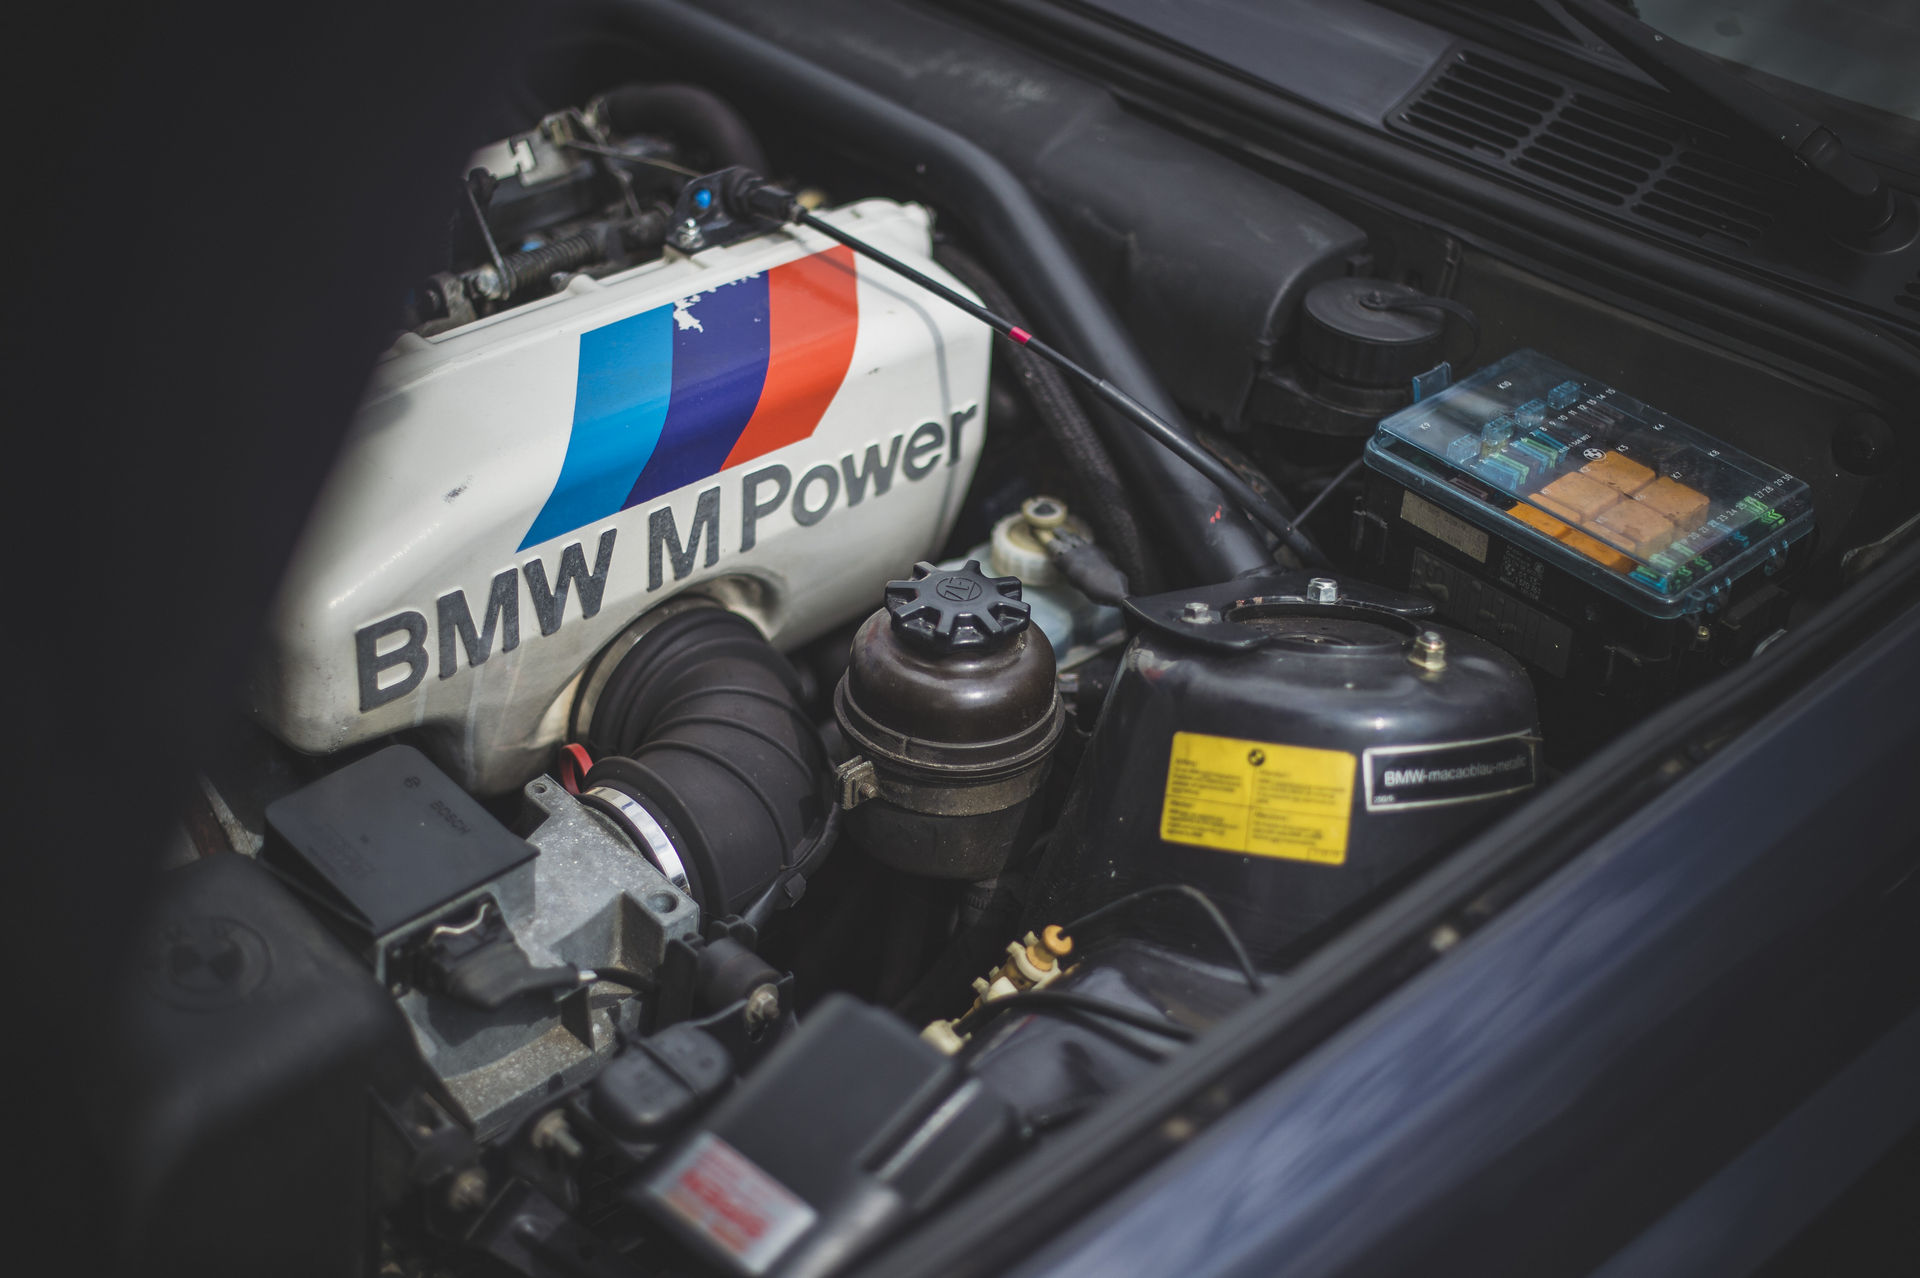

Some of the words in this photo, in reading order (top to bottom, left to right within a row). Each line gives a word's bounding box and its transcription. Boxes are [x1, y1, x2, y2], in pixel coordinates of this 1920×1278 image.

[1497, 380, 1512, 390] K10
[1557, 414, 1569, 422] 10
[1567, 409, 1578, 417] 11
[1577, 404, 1589, 412] 12
[1596, 393, 1607, 401] 14
[1605, 388, 1616, 396] 15
[1419, 422, 1431, 431] K9
[1652, 423, 1666, 432] K4
[1616, 444, 1630, 453] K3
[1671, 471, 1683, 480] K7
[1716, 514, 1729, 522] 23
[1725, 508, 1738, 516] 24
[1754, 490, 1765, 499] 27
[1774, 478, 1785, 487] 29
[1782, 473, 1794, 481] 30
[354, 528, 618, 713] BMW
[647, 485, 721, 593] M
[740, 402, 980, 553] Power
[429, 800, 472, 836] BOSCH
